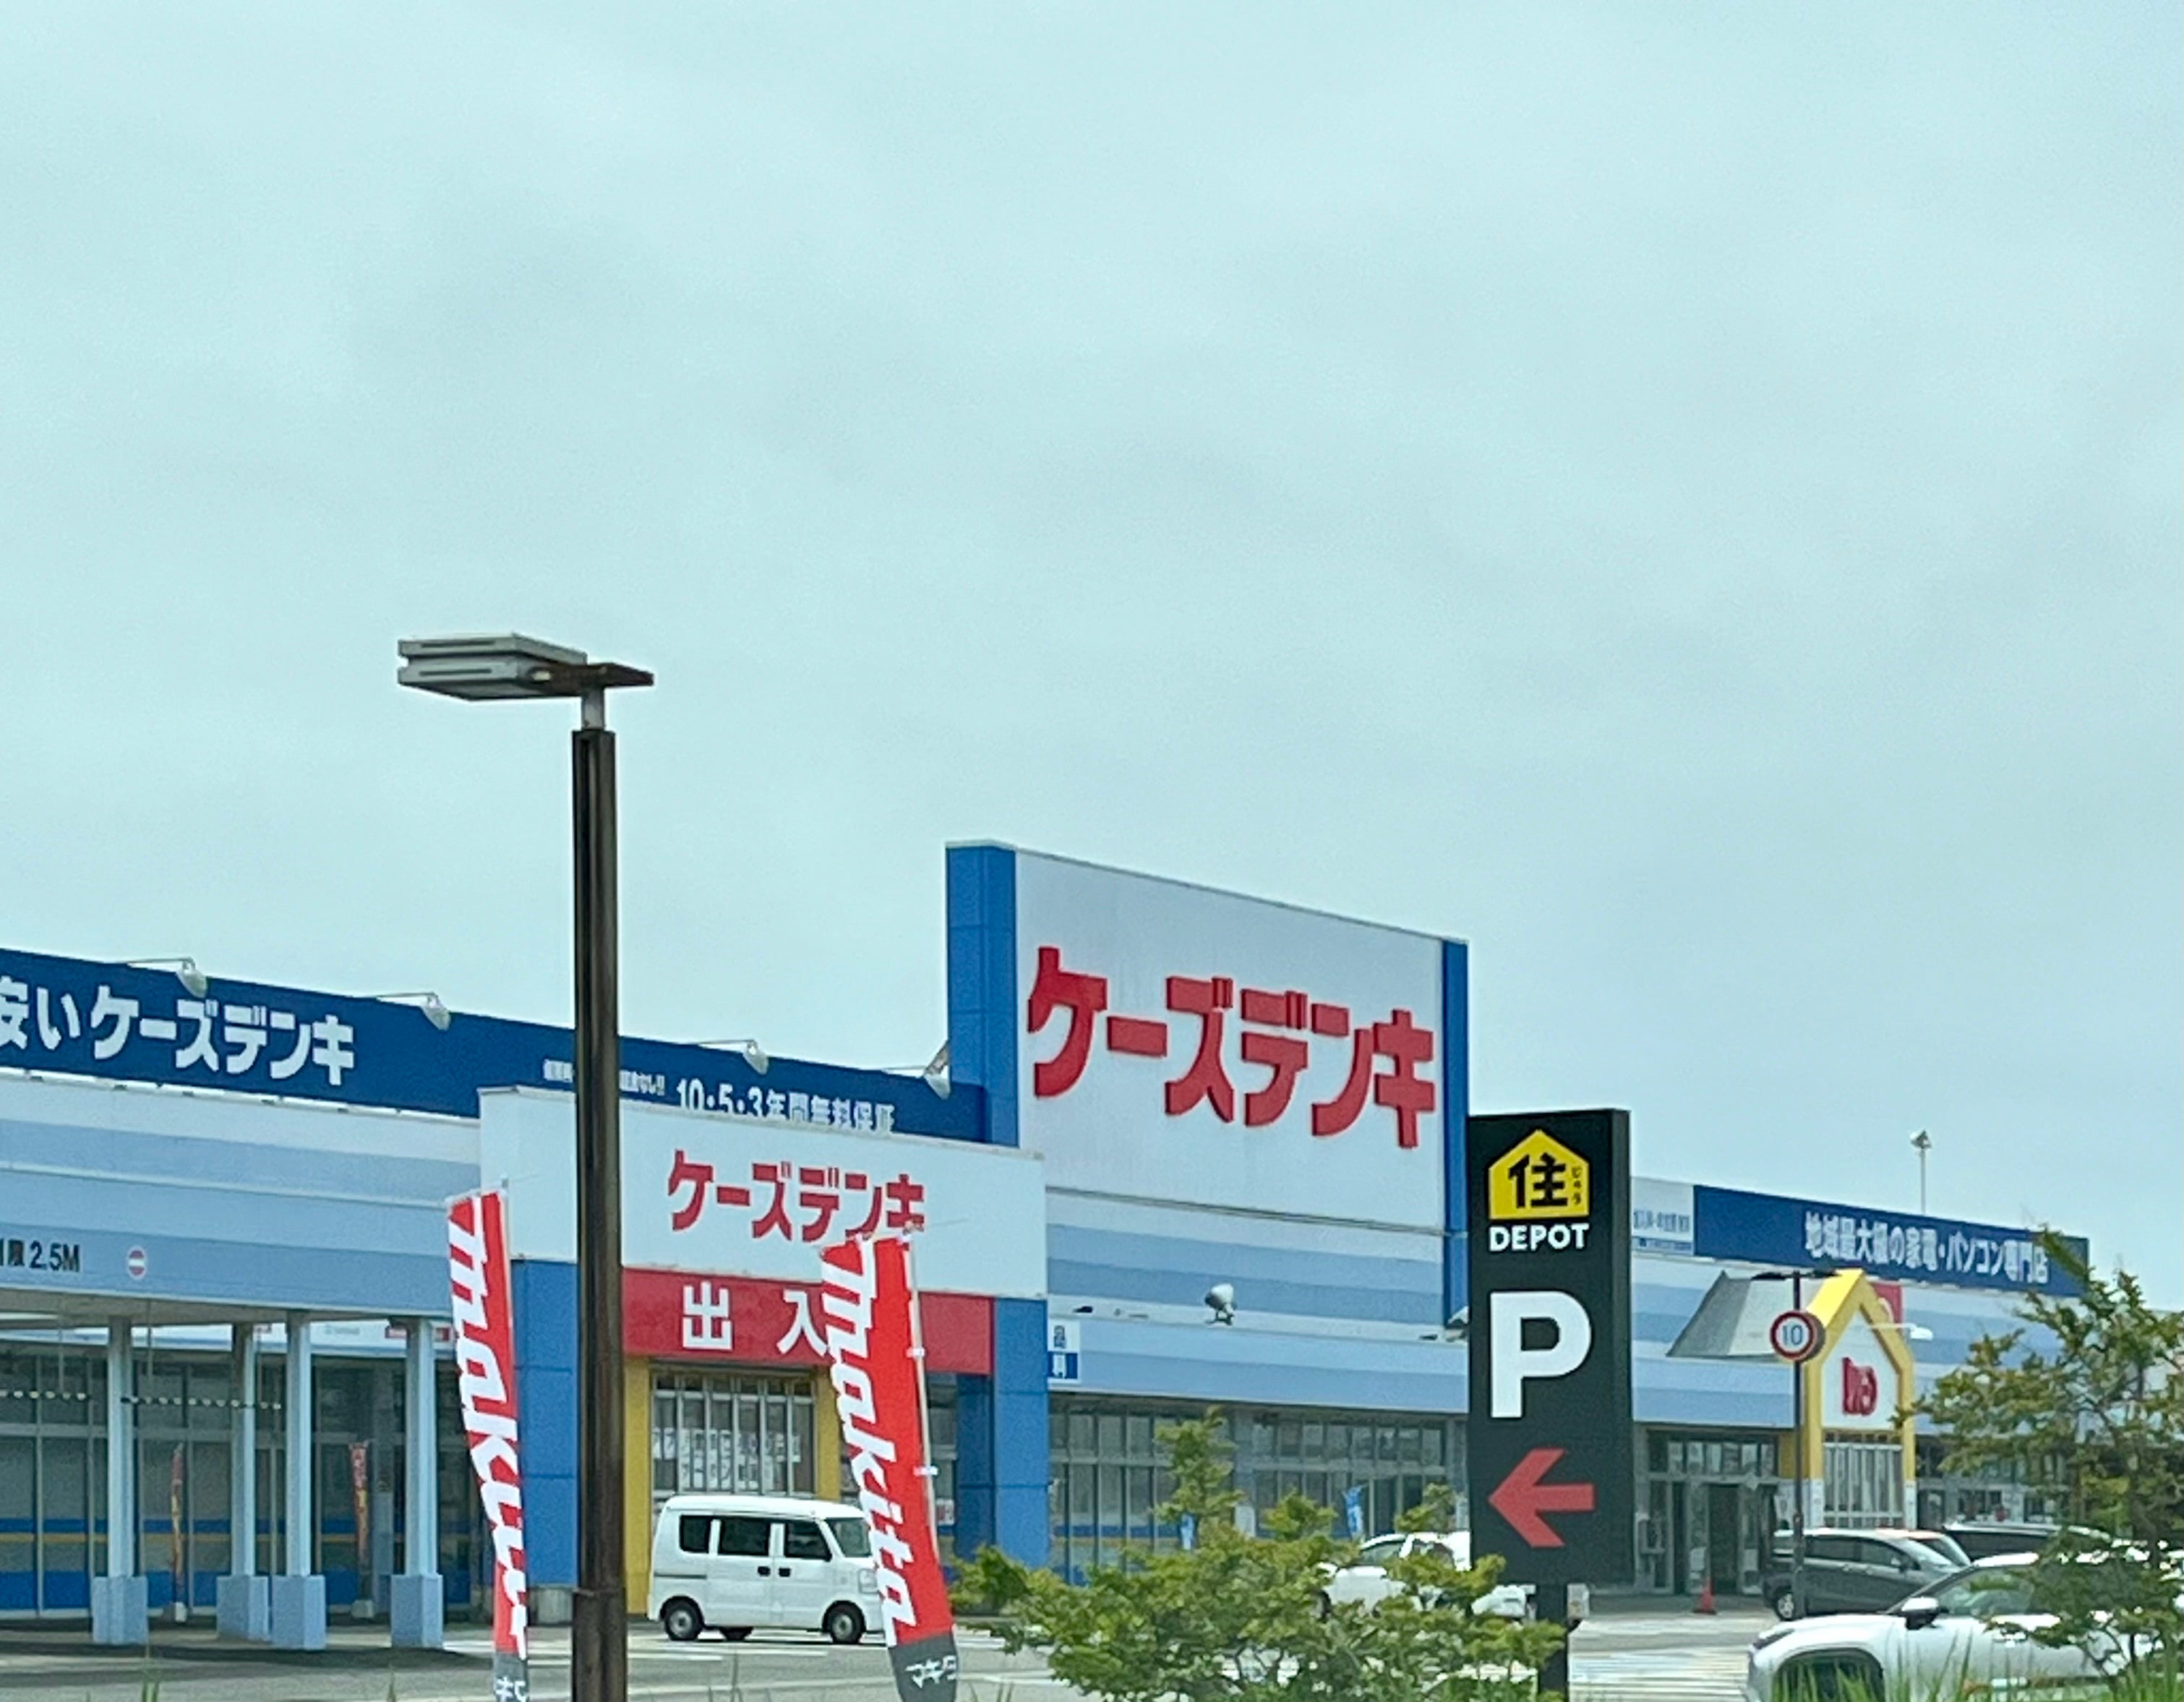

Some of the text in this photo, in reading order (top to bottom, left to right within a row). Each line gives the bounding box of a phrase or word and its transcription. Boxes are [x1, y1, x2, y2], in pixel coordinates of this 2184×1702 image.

[1027, 946, 1436, 1149] ケーズデンキ
[668, 1149, 925, 1242] ケーズデンキ
[1507, 1151, 1568, 1209] 住
[1489, 1222, 1590, 1252] DEPOT
[1490, 1291, 1592, 1419] P
[1781, 1325, 1804, 1346] 10
